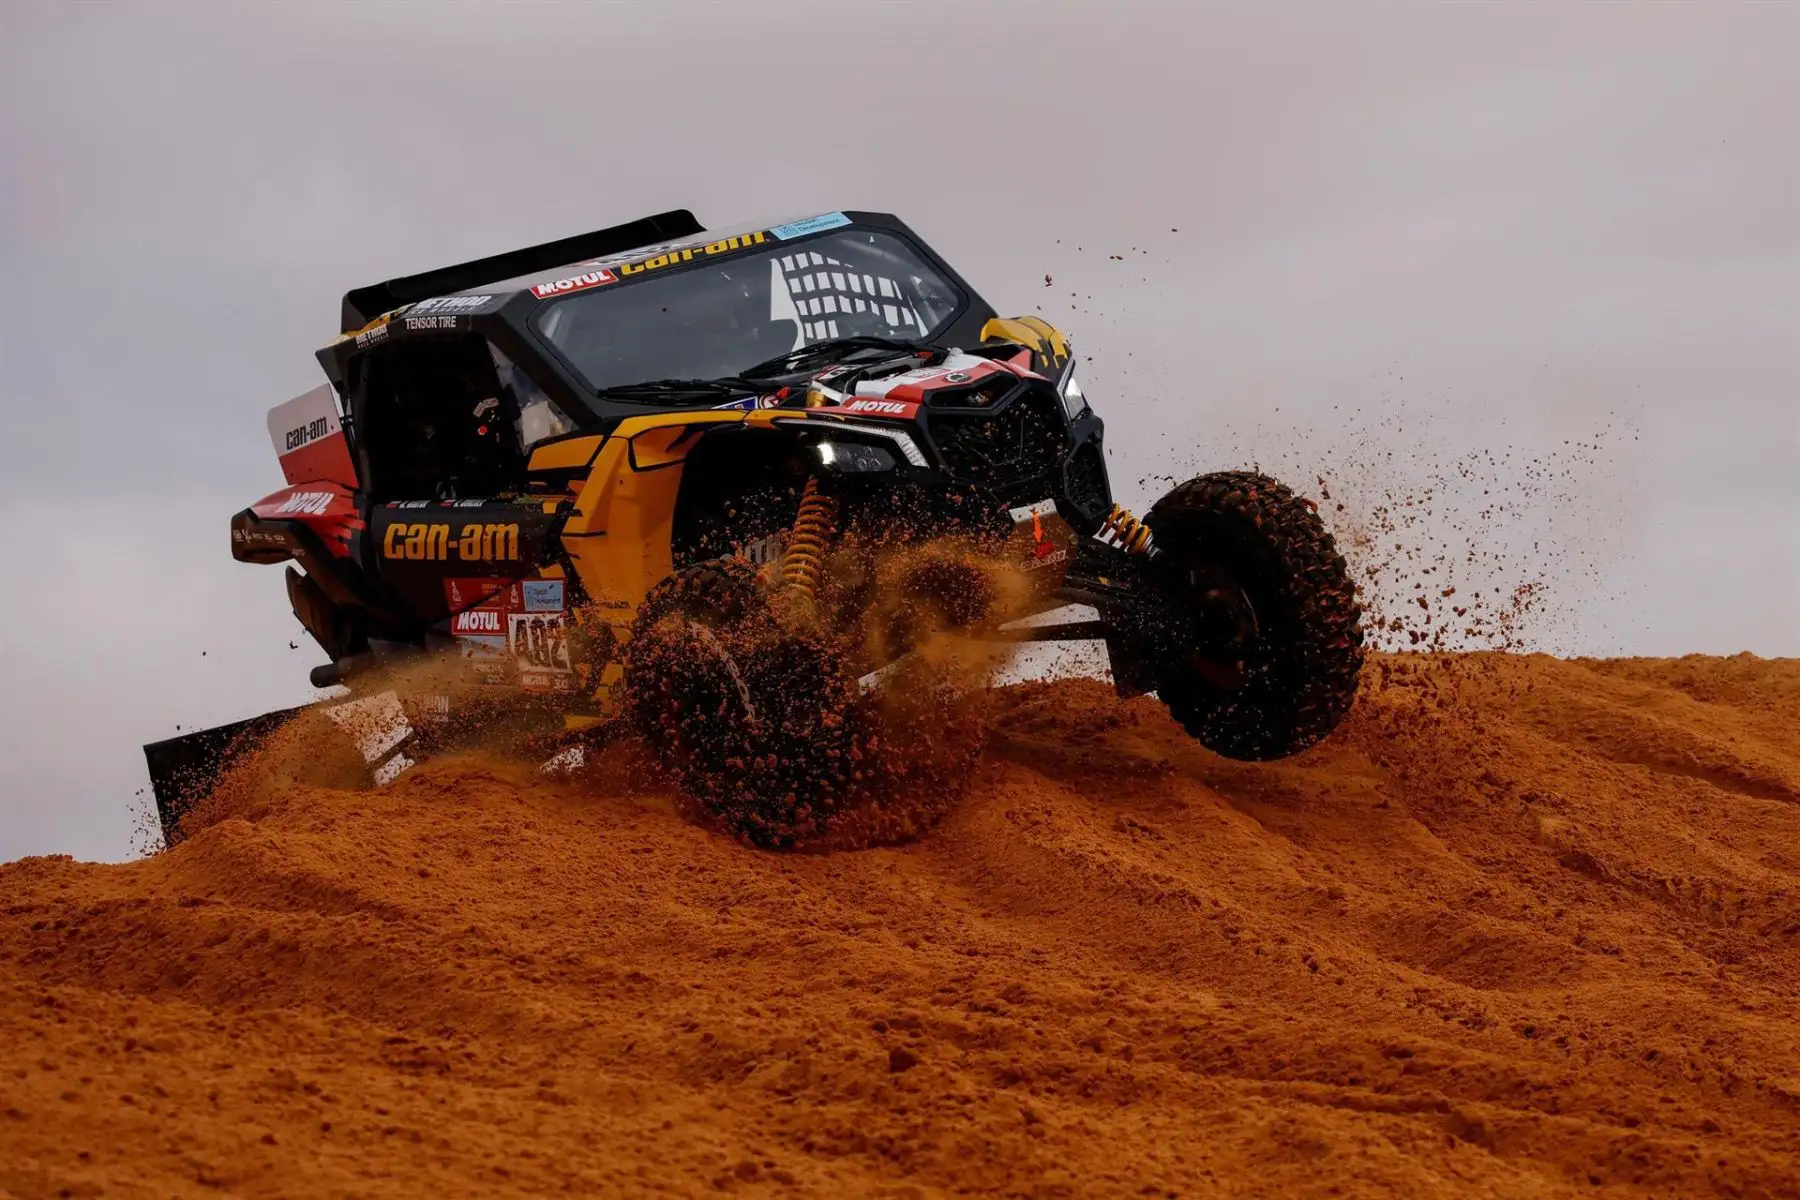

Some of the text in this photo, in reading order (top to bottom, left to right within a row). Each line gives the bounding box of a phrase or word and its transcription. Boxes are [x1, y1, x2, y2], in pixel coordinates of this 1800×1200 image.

[537, 231, 766, 296] MOTUL can-am
[406, 315, 457, 331] TENSOR TIRE
[848, 400, 906, 414] MOTUL
[285, 416, 329, 451] can-am
[383, 522, 520, 562] can-am
[456, 611, 501, 631] MOTUL
